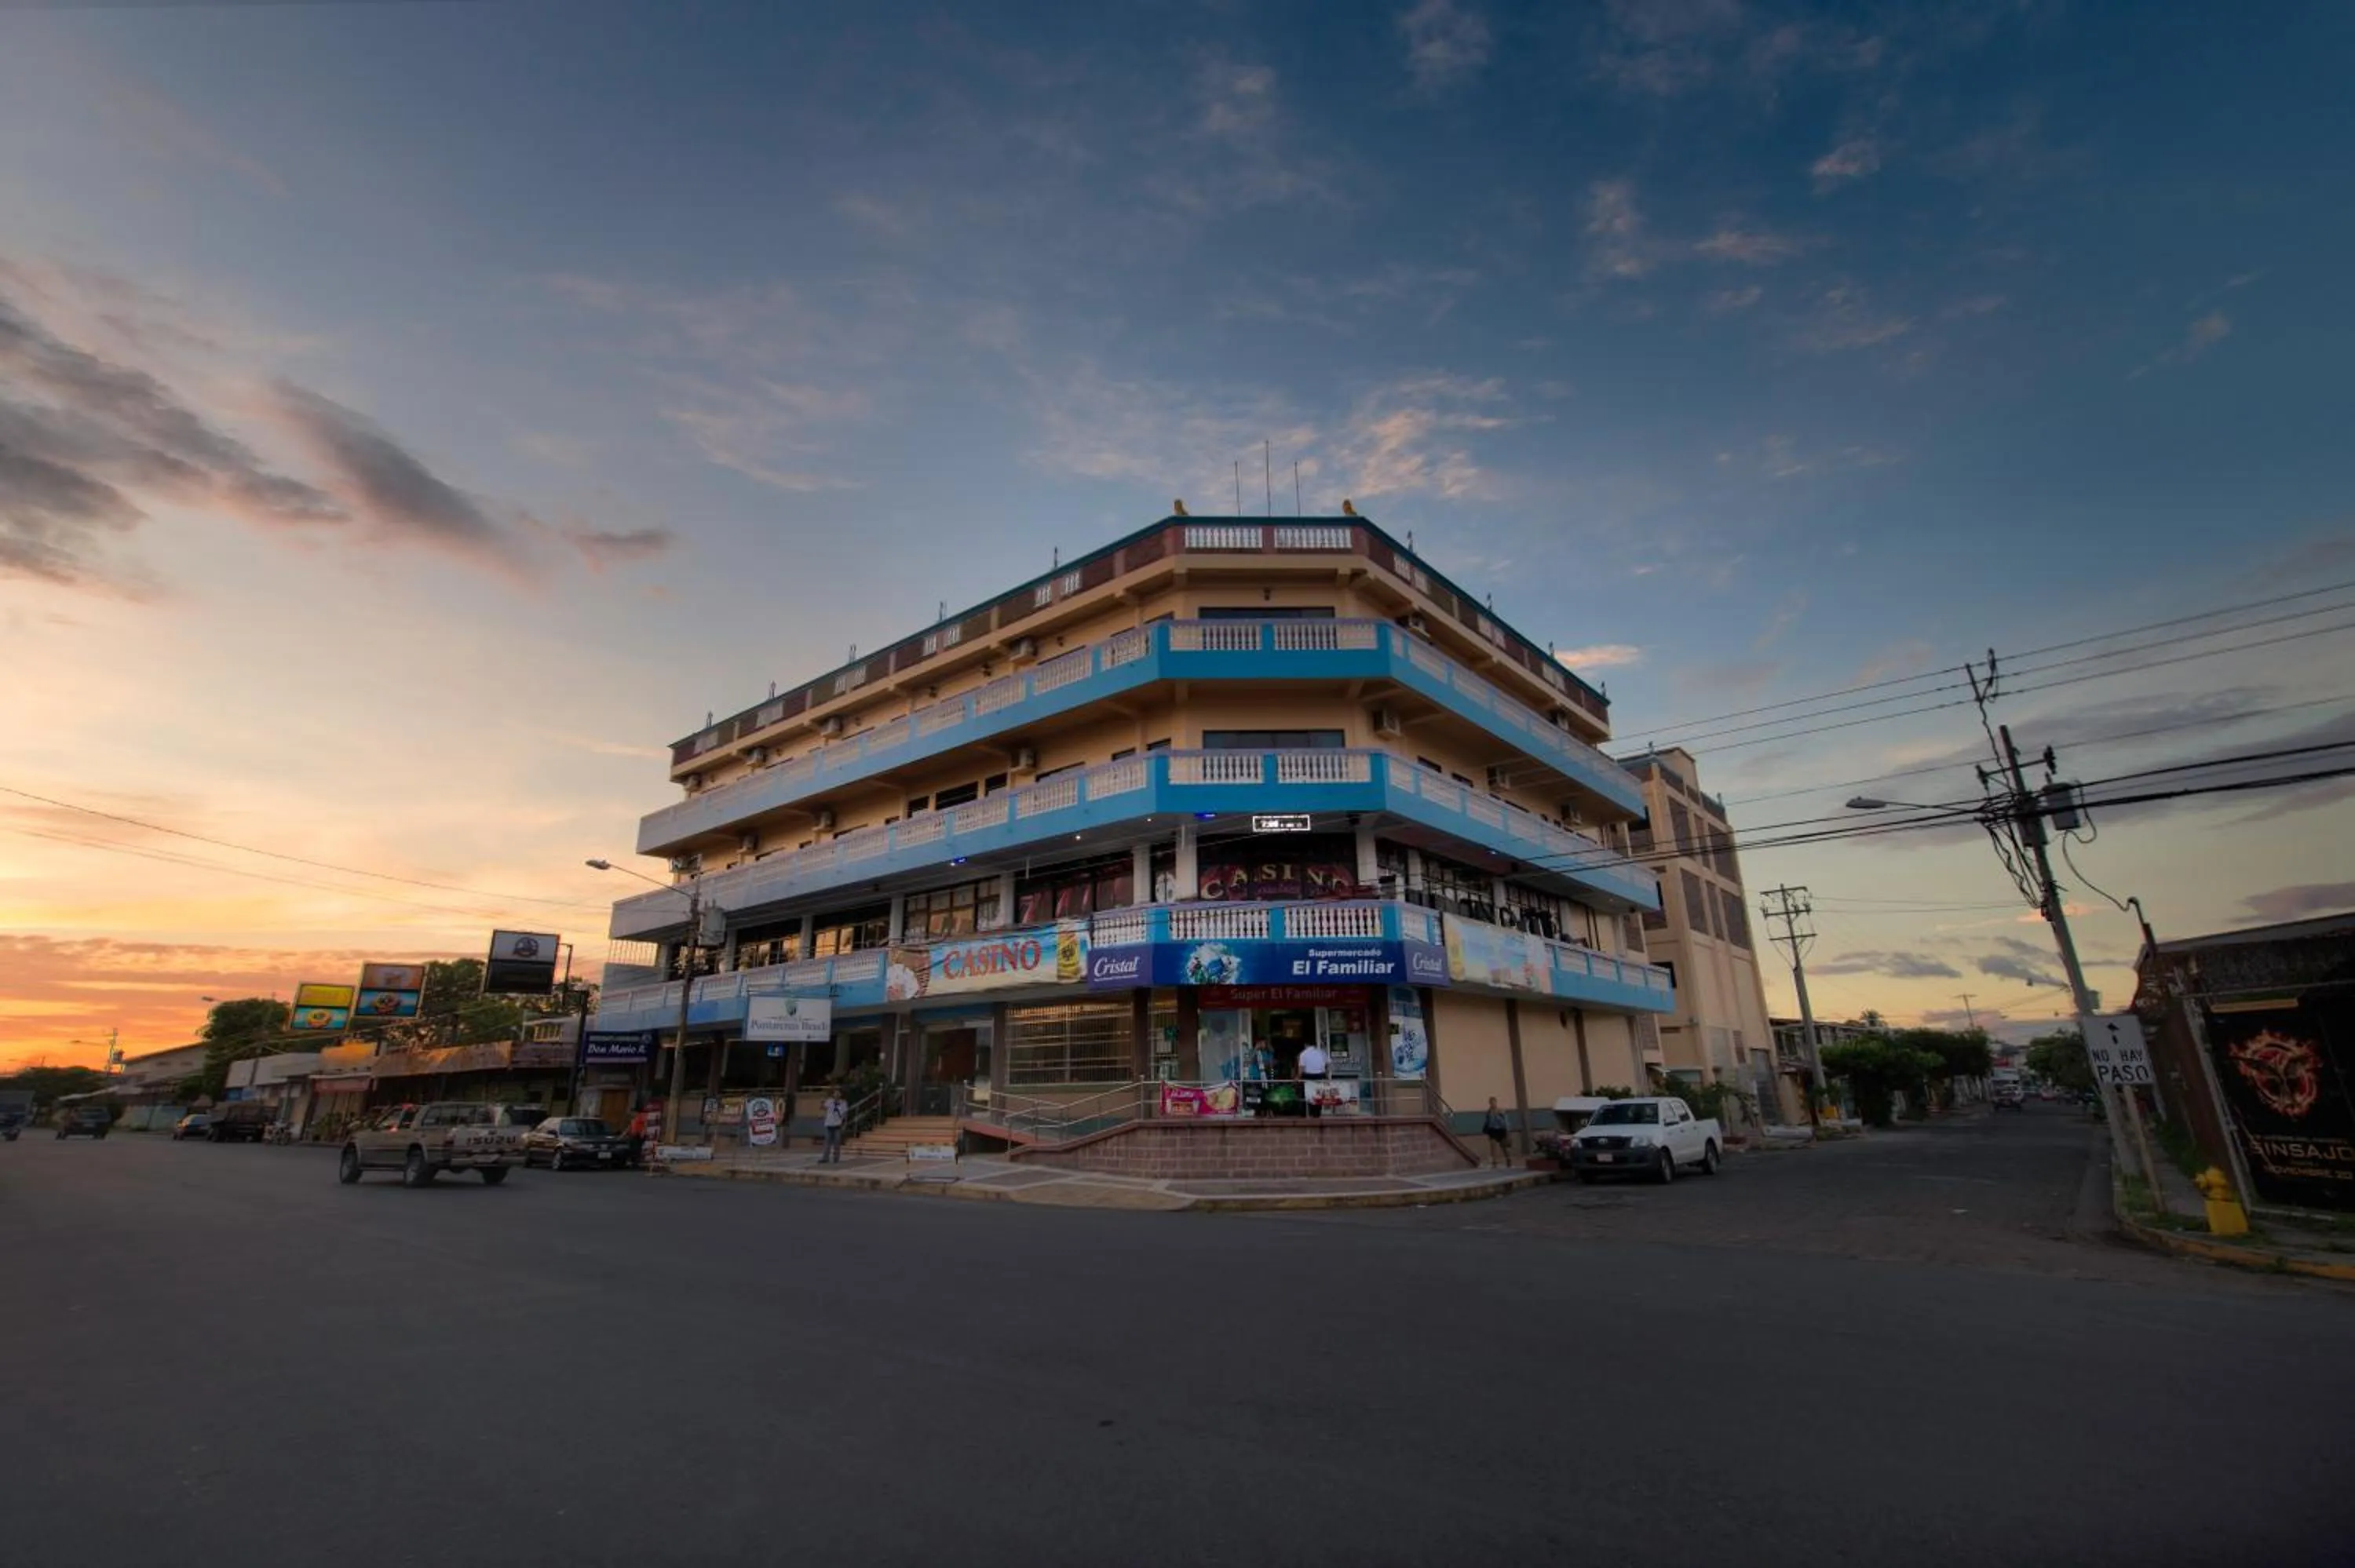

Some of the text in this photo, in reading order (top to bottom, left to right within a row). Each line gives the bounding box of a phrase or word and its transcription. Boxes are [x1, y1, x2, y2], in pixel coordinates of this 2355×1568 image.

[944, 940, 1042, 980] CASINO
[1308, 948, 1382, 958] Supermercado
[1094, 957, 1140, 977] Cristal
[1292, 959, 1396, 975] El Familiar
[1413, 952, 1442, 972] Cristal
[1230, 986, 1340, 1002] Super El Familiar
[2091, 1048, 2142, 1063] NO HAY
[2097, 1064, 2149, 1082] PASO
[466, 1136, 517, 1146] ISUZU
[2250, 1141, 2355, 1162] SINSAJO
